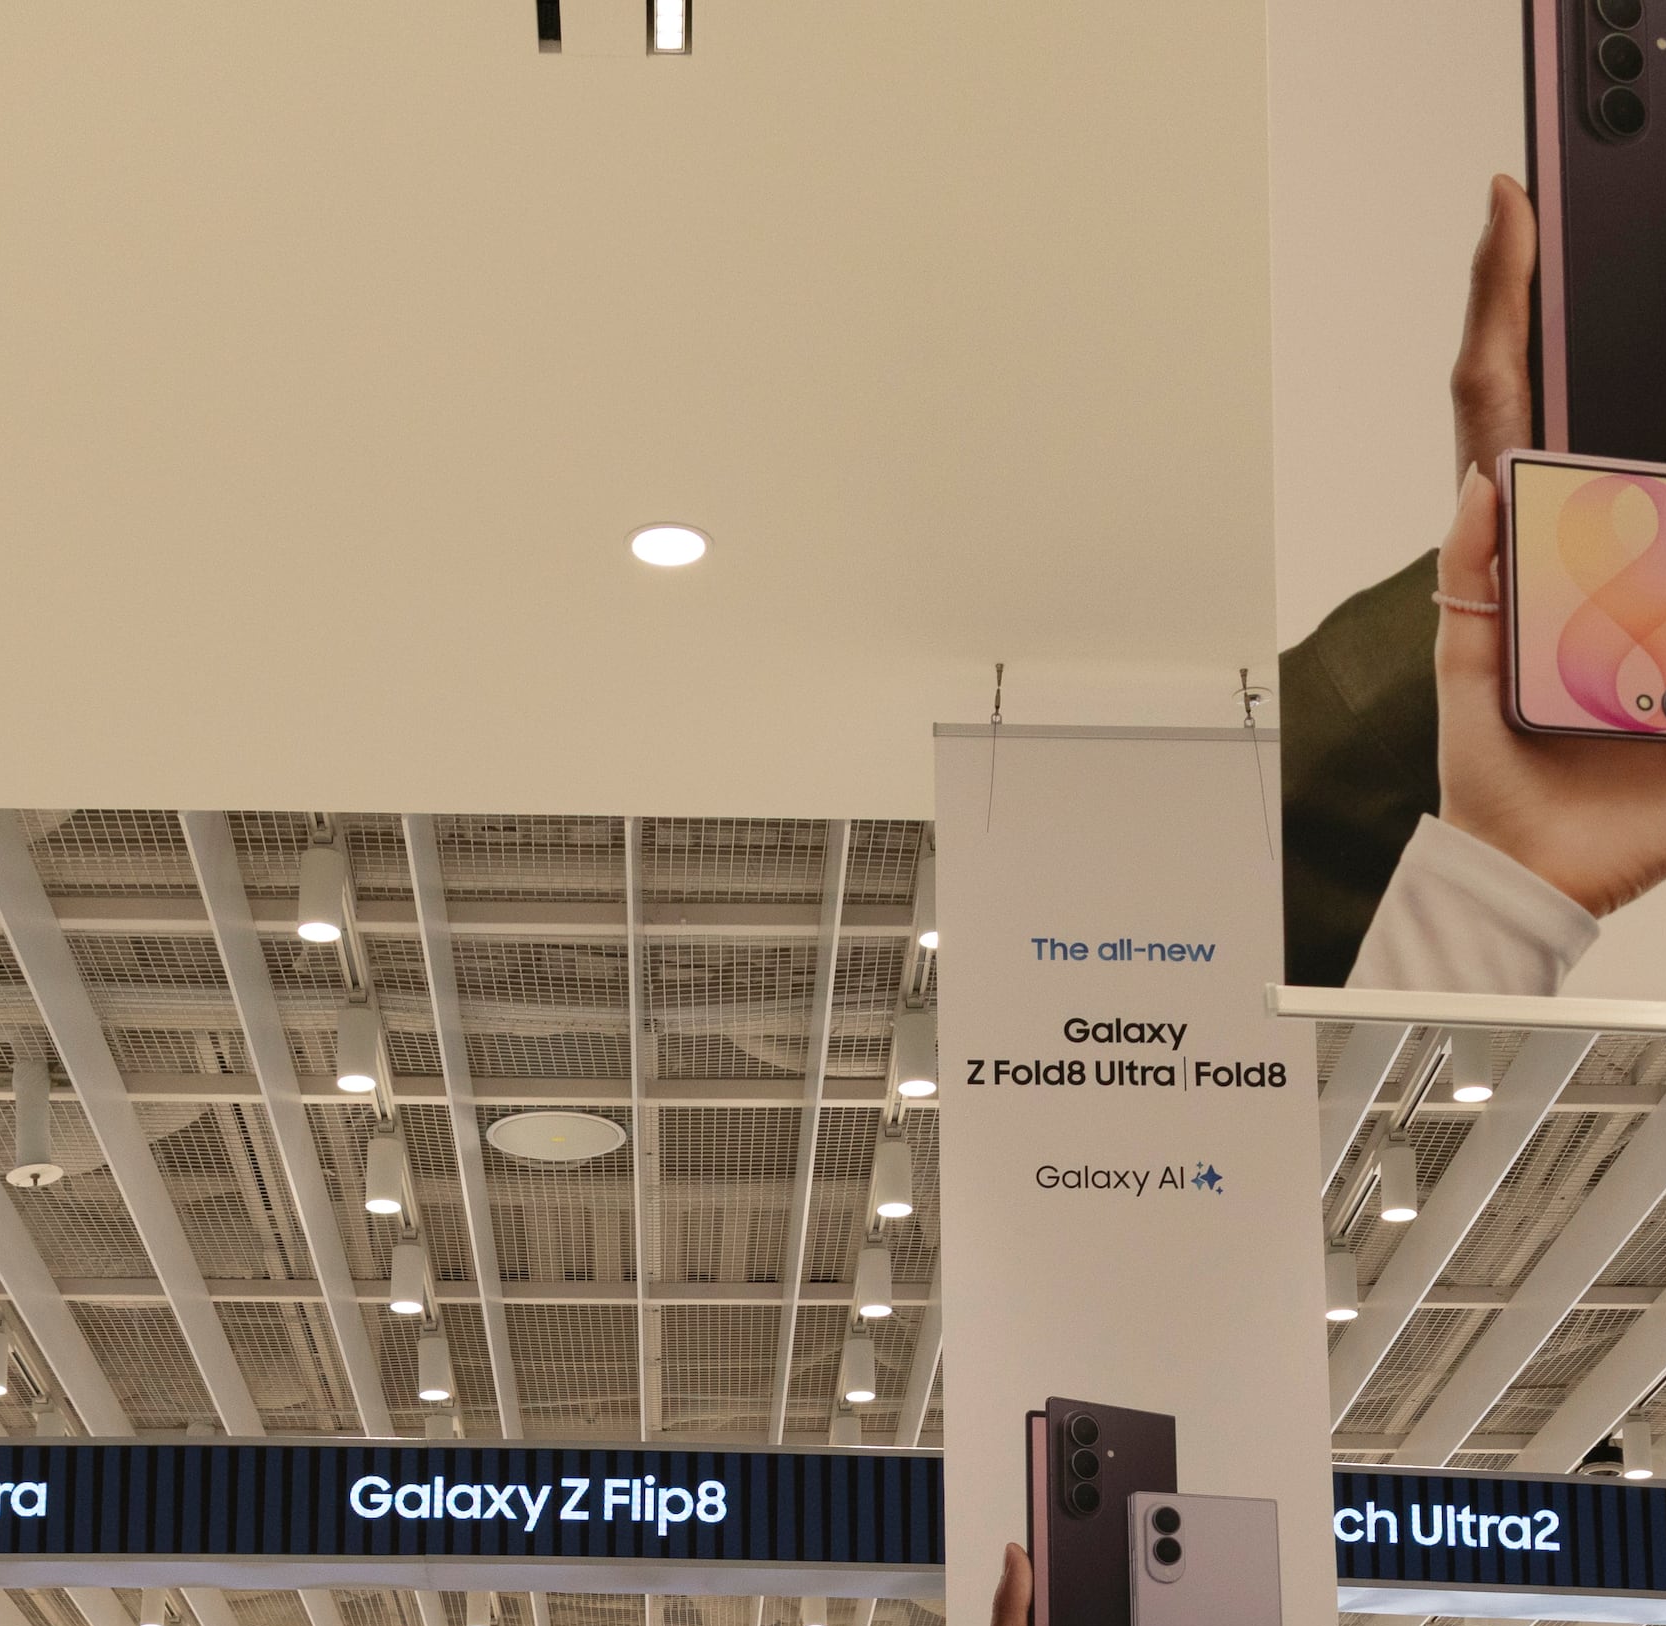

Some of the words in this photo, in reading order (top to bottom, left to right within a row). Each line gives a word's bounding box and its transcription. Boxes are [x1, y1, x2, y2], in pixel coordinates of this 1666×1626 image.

[1031, 938, 1089, 961] The
[1097, 938, 1216, 962] all-new
[1063, 1018, 1187, 1050] Galaxy
[967, 1060, 985, 1085] Z
[994, 1060, 1086, 1086] Fold8
[1095, 1060, 1175, 1086] Ultra
[1195, 1062, 1287, 1088] Fold8
[1036, 1165, 1150, 1196] Galaxy
[1158, 1166, 1185, 1189] AI
[350, 1476, 551, 1531] Galaxy
[560, 1478, 589, 1520] Z
[604, 1475, 726, 1536] Flip8
[1334, 1502, 1397, 1543] ch
[1412, 1504, 1560, 1550] Ultra2
